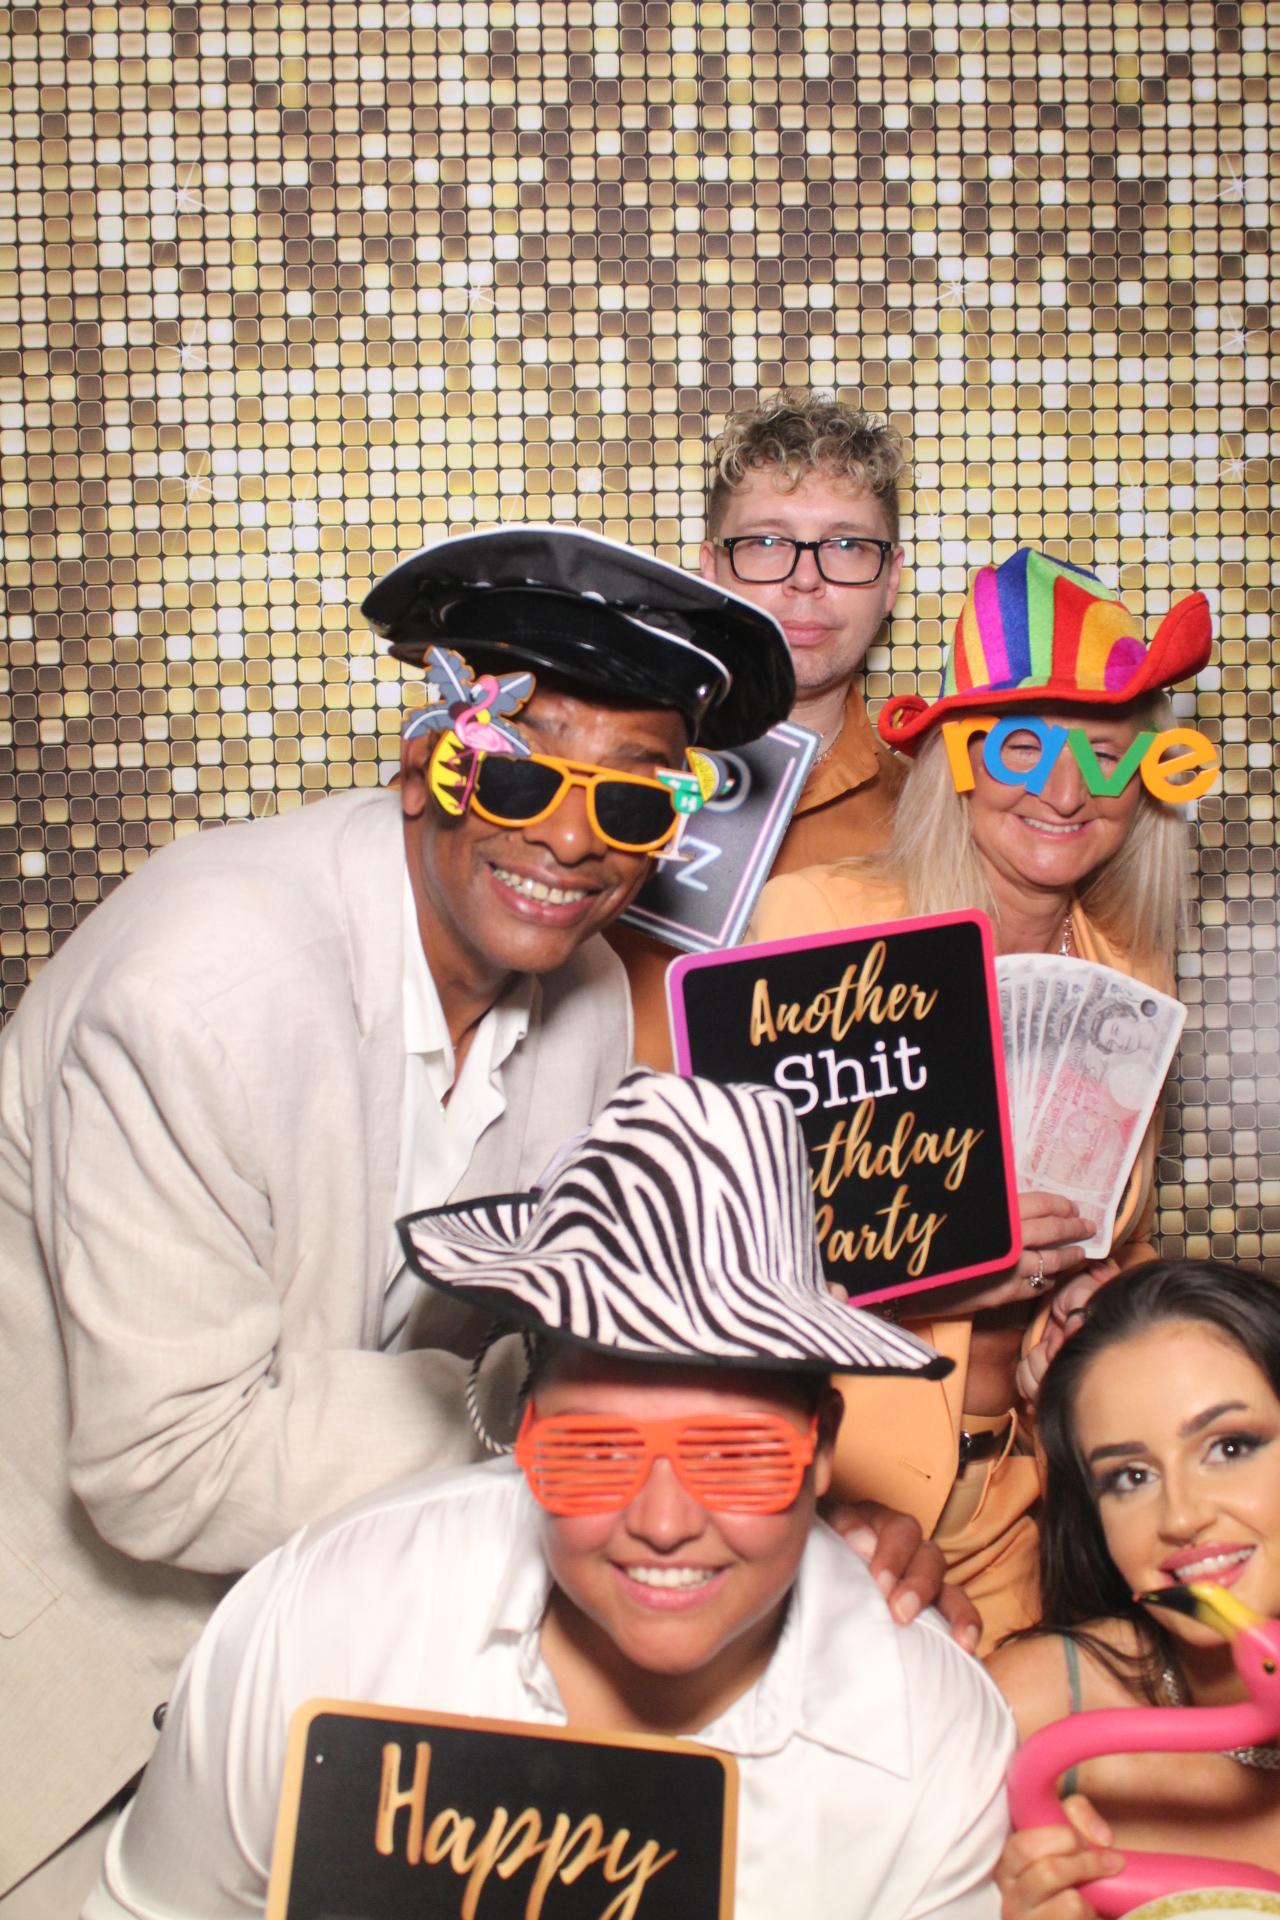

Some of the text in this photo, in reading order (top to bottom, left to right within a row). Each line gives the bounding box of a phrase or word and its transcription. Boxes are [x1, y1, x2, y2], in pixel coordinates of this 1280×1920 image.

[942, 715, 1221, 804] rave
[749, 940, 939, 1047] Another
[774, 1035, 928, 1117] Shit
[810, 1096, 985, 1191] thday
[374, 1741, 678, 1920] Happy
